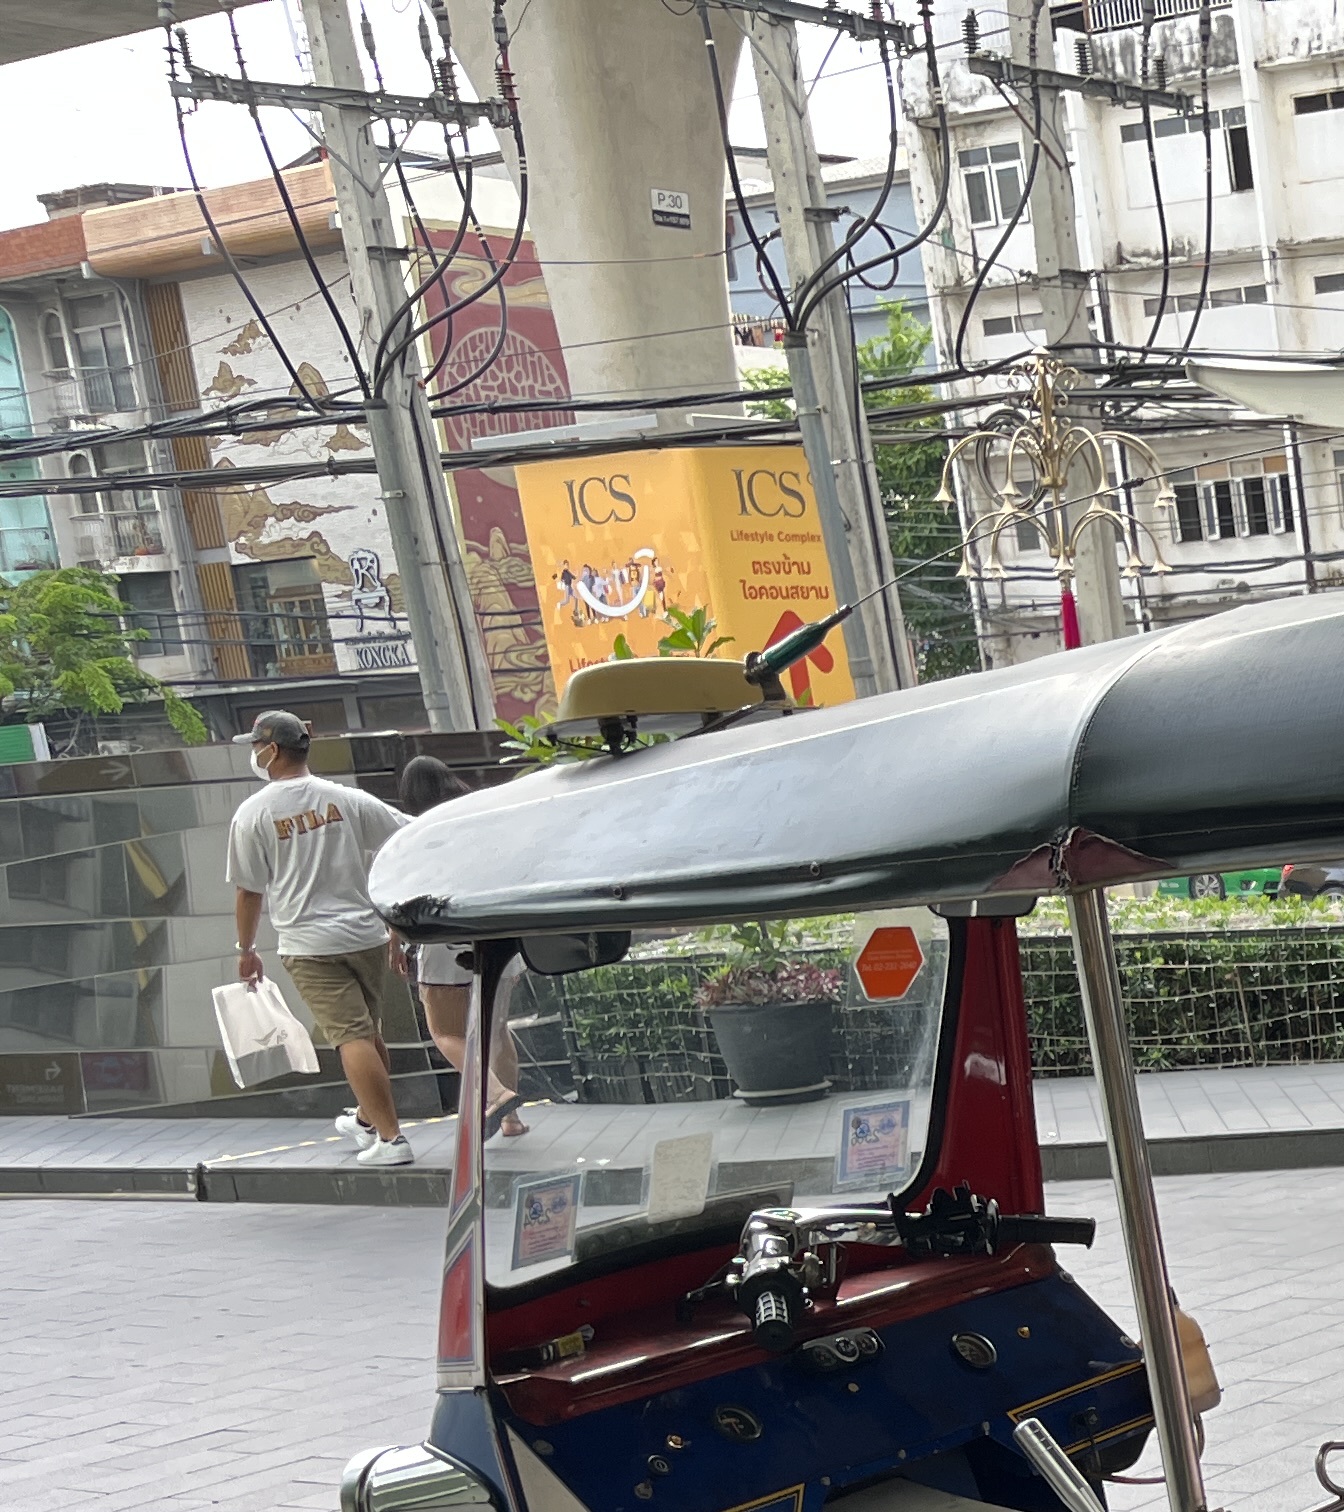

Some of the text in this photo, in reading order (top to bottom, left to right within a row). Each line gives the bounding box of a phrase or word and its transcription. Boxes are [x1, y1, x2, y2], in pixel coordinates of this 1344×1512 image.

[657, 192, 683, 210] P.30
[563, 473, 637, 527] ICS
[731, 468, 806, 518] ICS
[730, 529, 822, 544] Lifestyle Complex
[751, 553, 812, 575] ตรงข้าม
[739, 579, 829, 601] ไอคอนสยาม
[568, 655, 609, 673] Lifest
[273, 803, 343, 840] FILA
